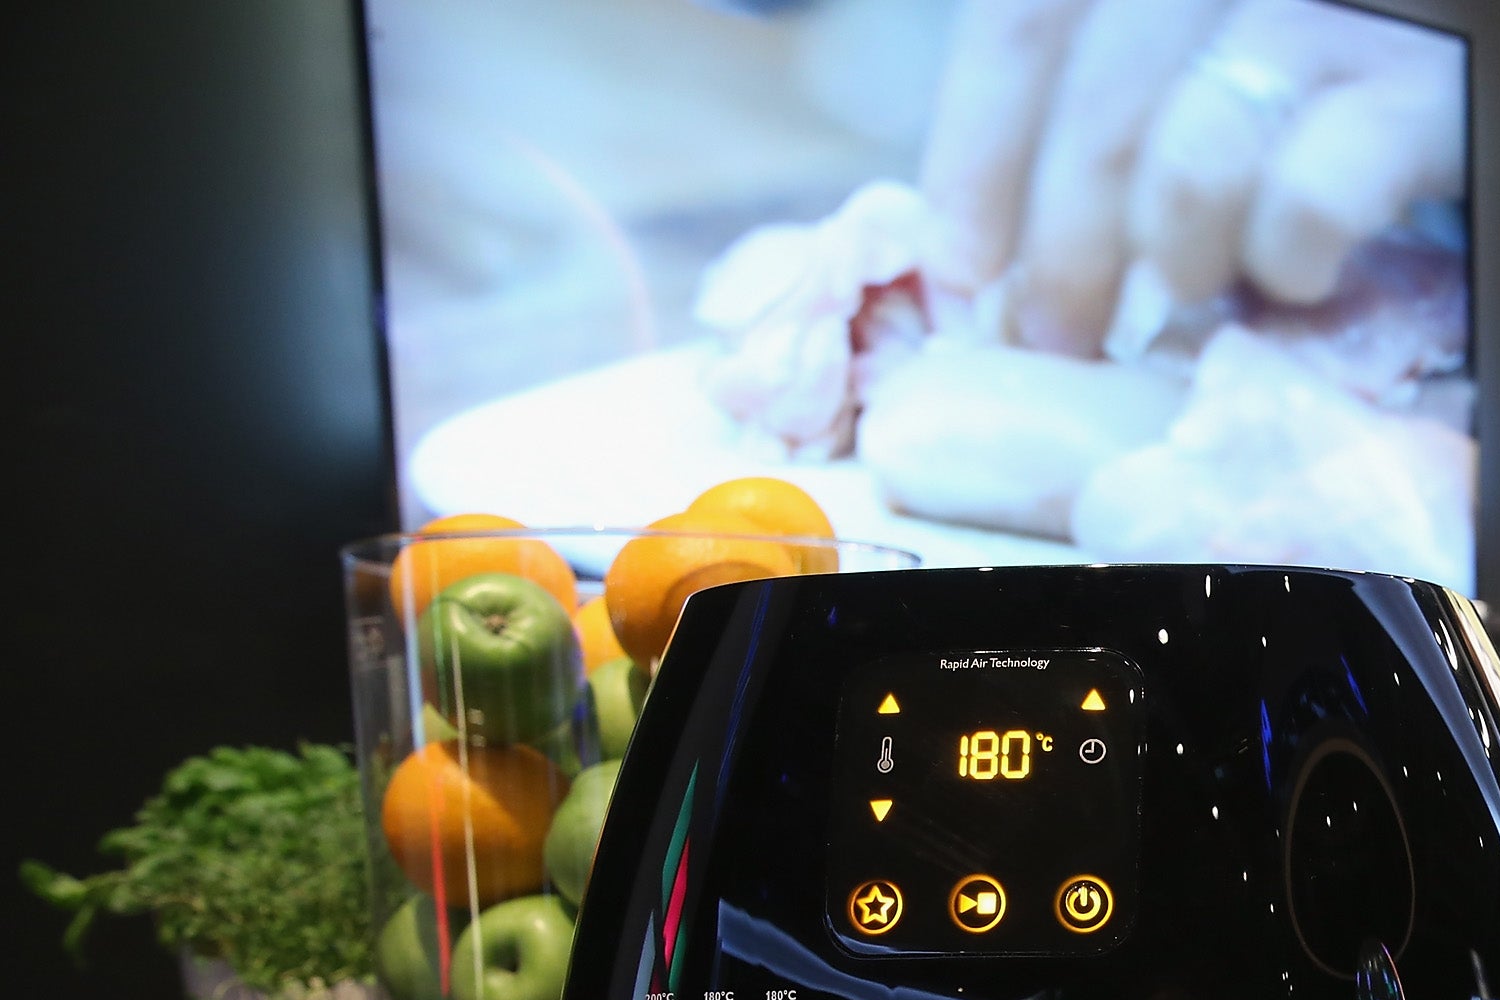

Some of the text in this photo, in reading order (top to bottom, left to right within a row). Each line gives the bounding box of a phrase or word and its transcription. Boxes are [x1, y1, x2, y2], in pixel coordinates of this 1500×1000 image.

[939, 656, 1050, 671] Rapid Air Technology
[958, 730, 1031, 780] 180
[765, 990, 797, 1000] 180°C
